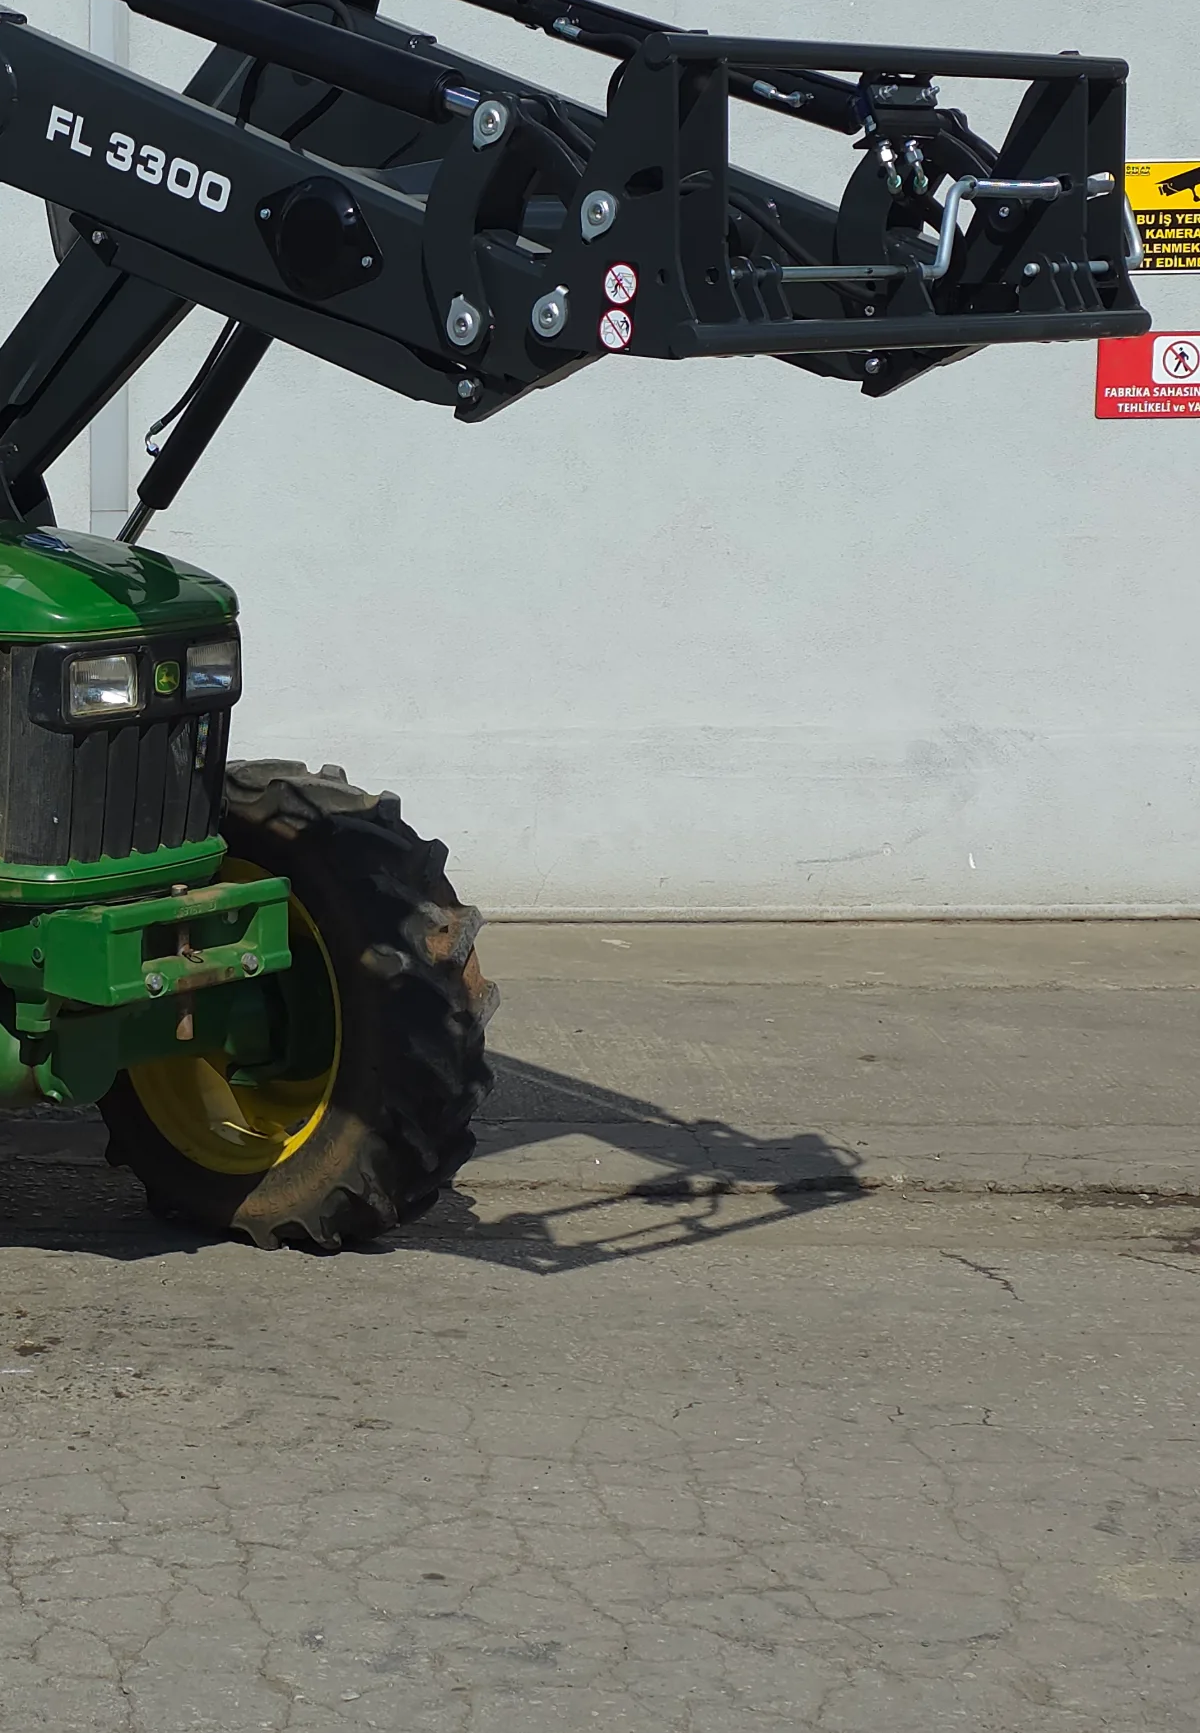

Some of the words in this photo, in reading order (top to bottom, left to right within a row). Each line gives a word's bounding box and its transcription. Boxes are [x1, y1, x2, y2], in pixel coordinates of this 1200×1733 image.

[46, 105, 92, 157] FL
[106, 132, 231, 212] 3300
[1136, 214, 1155, 225] BU
[1159, 212, 1172, 227] İŞ
[1104, 385, 1150, 397] FABRİKA
[1117, 400, 1171, 413] TEHLİKELİ
[1173, 404, 1185, 412] ve
